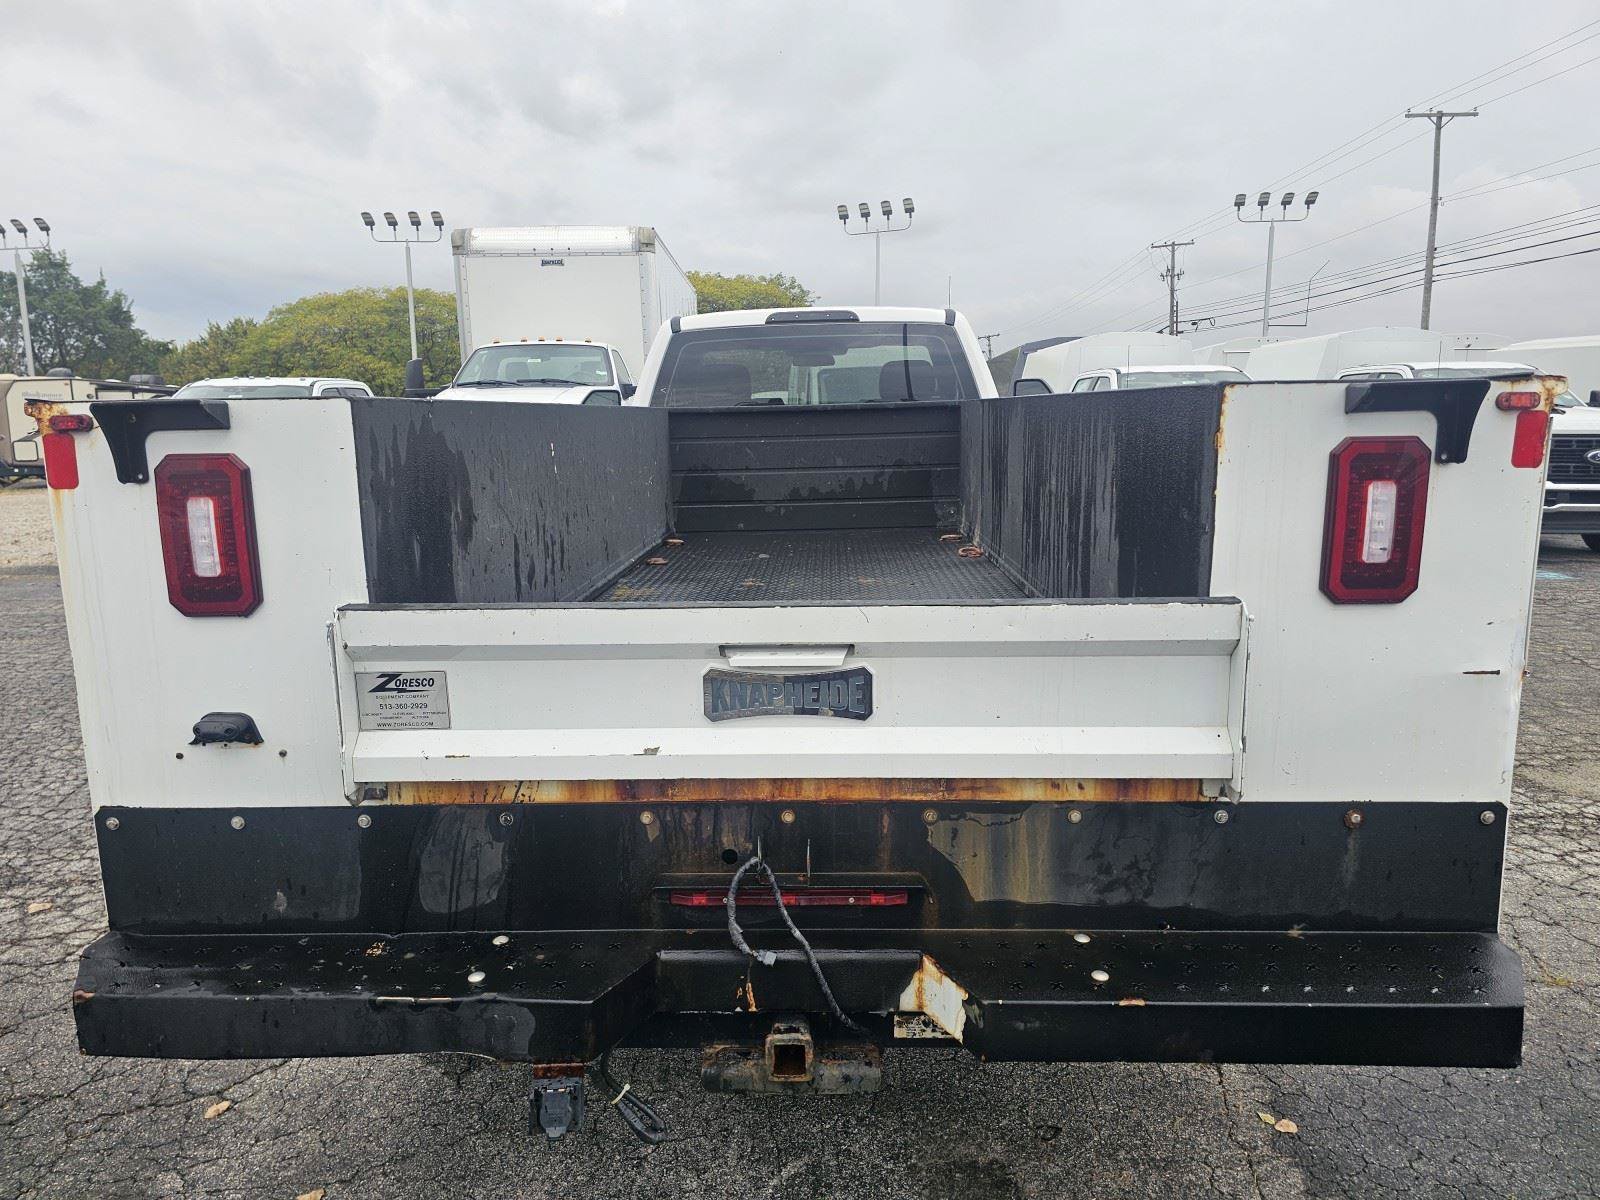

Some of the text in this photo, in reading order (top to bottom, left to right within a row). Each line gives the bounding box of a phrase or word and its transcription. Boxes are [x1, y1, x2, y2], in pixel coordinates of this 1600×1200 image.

[368, 673, 435, 692] ZORESCO
[710, 675, 865, 713] KNAPHEIDE
[379, 702, 428, 710] 513-360-2929
